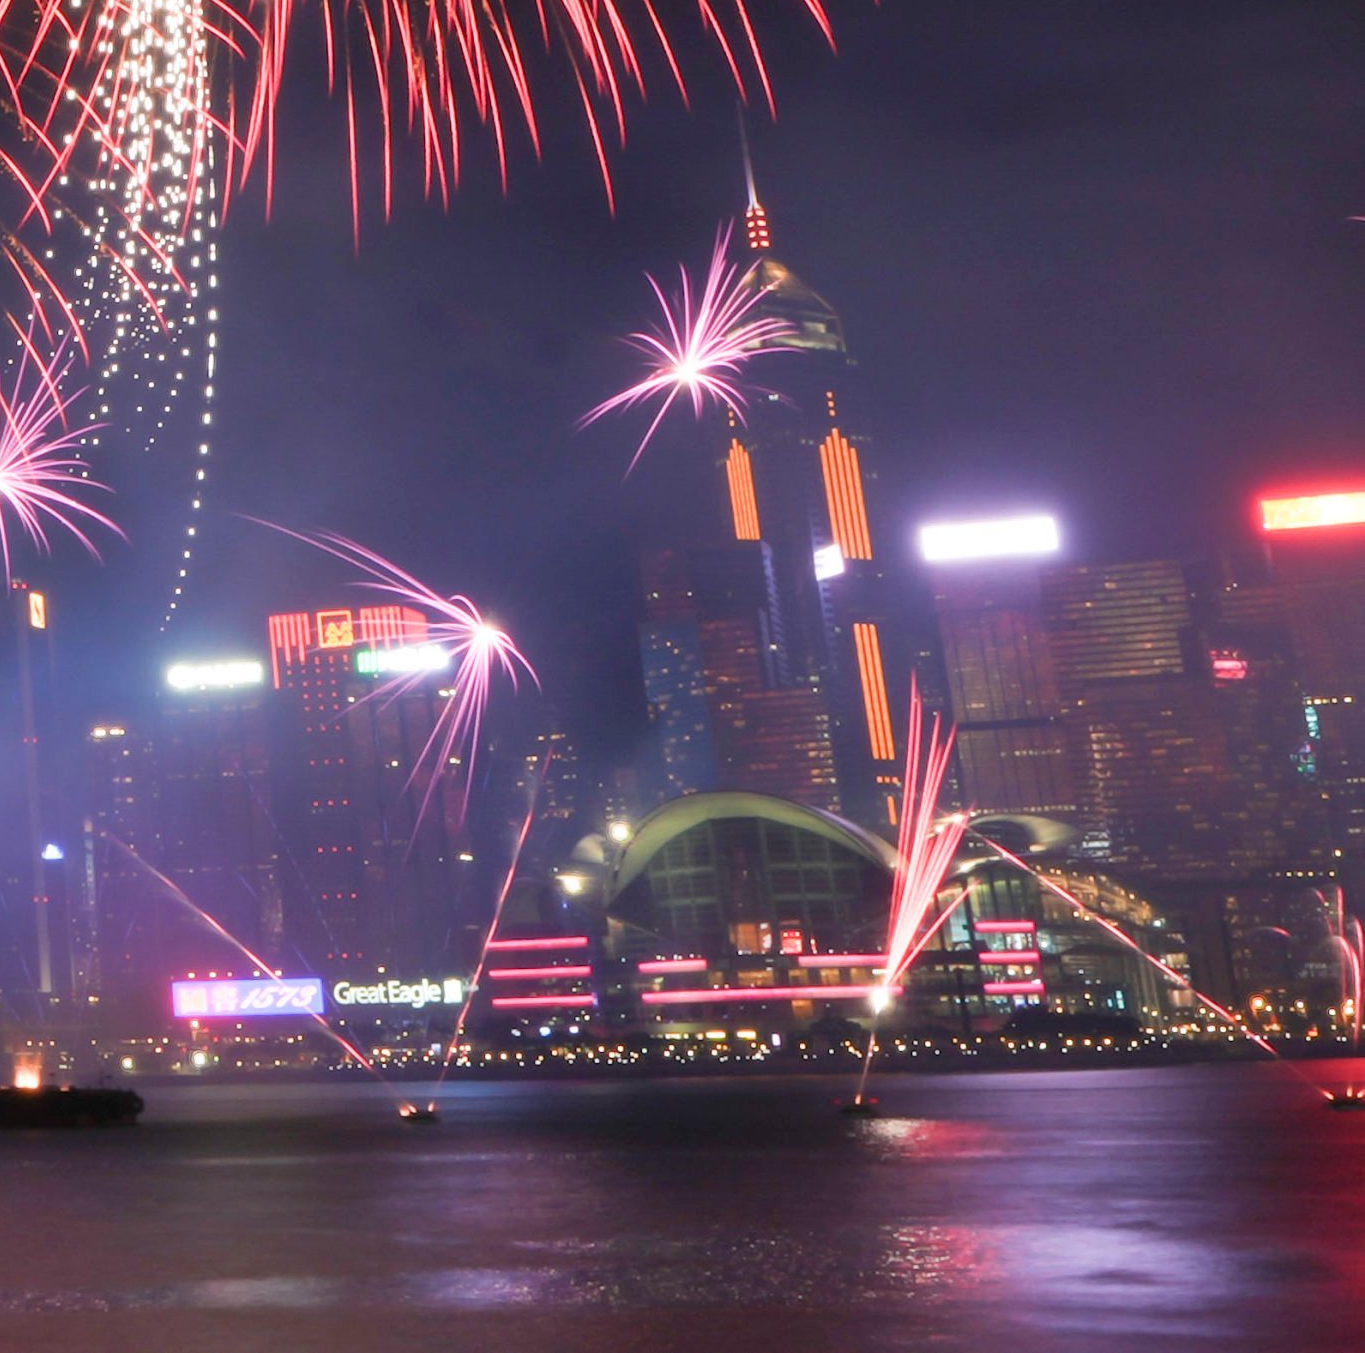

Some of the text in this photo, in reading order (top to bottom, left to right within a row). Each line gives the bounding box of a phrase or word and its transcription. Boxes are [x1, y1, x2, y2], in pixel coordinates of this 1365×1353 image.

[240, 985, 317, 1009] 1573
[333, 978, 441, 1008] Great Eagle
